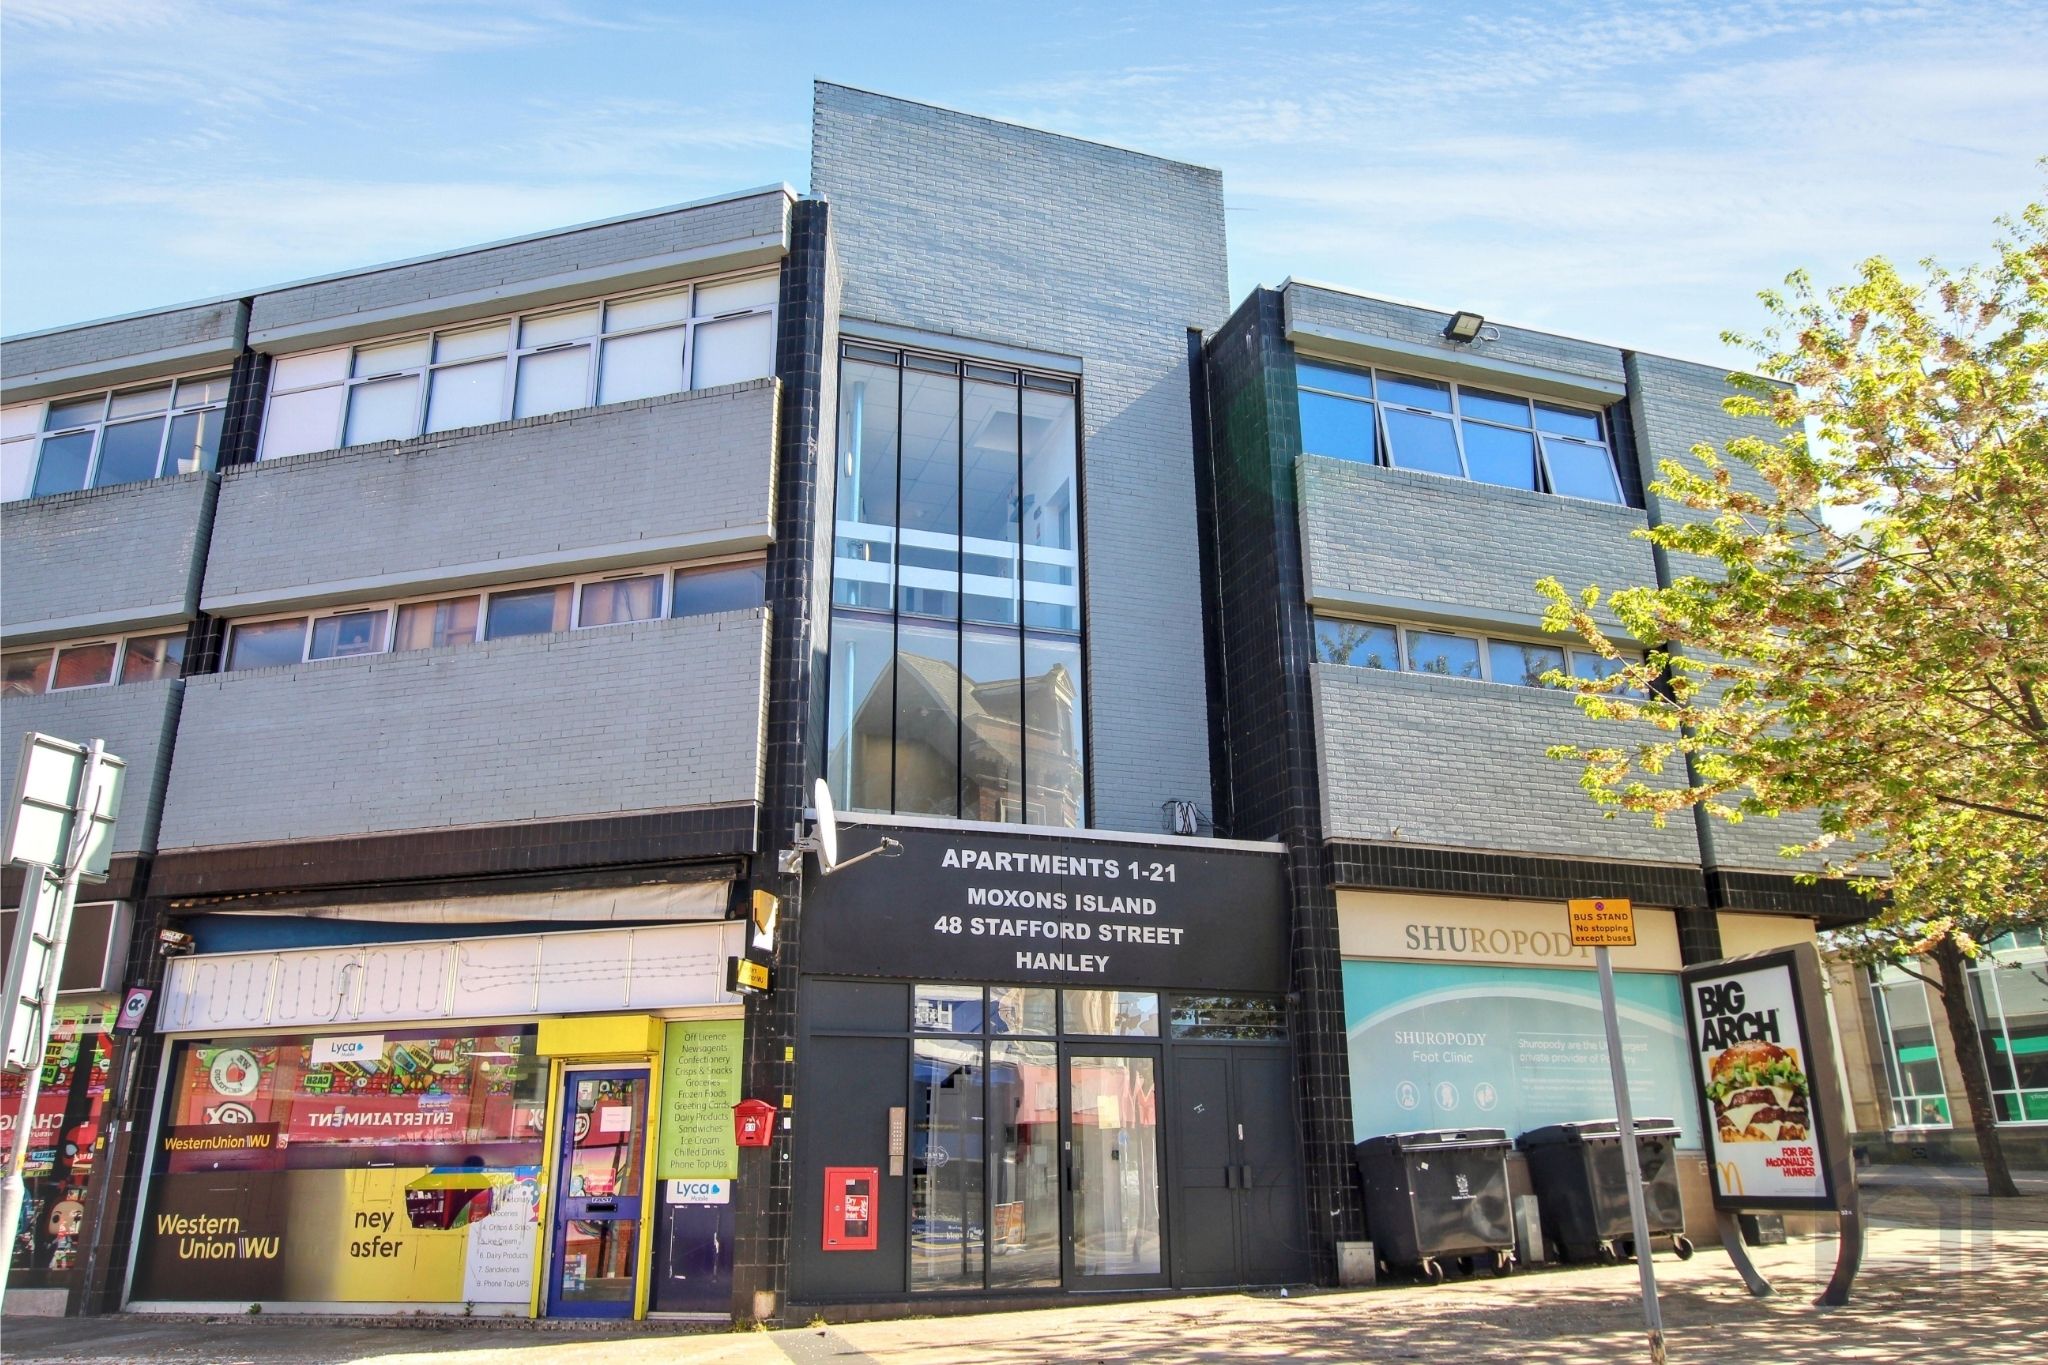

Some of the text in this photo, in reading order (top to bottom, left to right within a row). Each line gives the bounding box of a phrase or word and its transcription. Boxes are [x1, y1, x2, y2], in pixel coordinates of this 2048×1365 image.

[941, 848, 1176, 882] APARTMENTS 1-21
[967, 888, 1157, 915] MOXONS ISLAND
[934, 915, 1184, 945] 48 STAFFORD STREET
[1405, 924, 1589, 958] SHUROPOD
[1016, 951, 1109, 973] HANLEY
[1697, 981, 1745, 1019] BIG
[685, 1033, 696, 1041] Off
[1702, 1009, 1780, 1052] ARCH
[1394, 1031, 1487, 1046] SHUROPODY
[331, 1042, 356, 1054] Lyca
[1413, 1050, 1473, 1063] Foot Clinic
[699, 1066, 704, 1074] &
[678, 1090, 702, 1099] Frozen
[674, 1101, 730, 1111] Greeting Cards
[674, 1112, 728, 1123] Dairy Products
[678, 1125, 722, 1134] Sandwiches
[249, 1134, 270, 1148] WU
[694, 1136, 720, 1145] Cream
[674, 1147, 725, 1157] Chilled Drinks
[1782, 1147, 1813, 1157] FOR BIG
[670, 1160, 694, 1169] Phone
[1766, 1157, 1815, 1167] McDONALD'S
[1783, 1167, 1816, 1177] HUNGER
[677, 1181, 710, 1197] Lyca
[158, 1213, 240, 1235] Western
[355, 1211, 394, 1233] ney
[180, 1236, 280, 1259] Union WU
